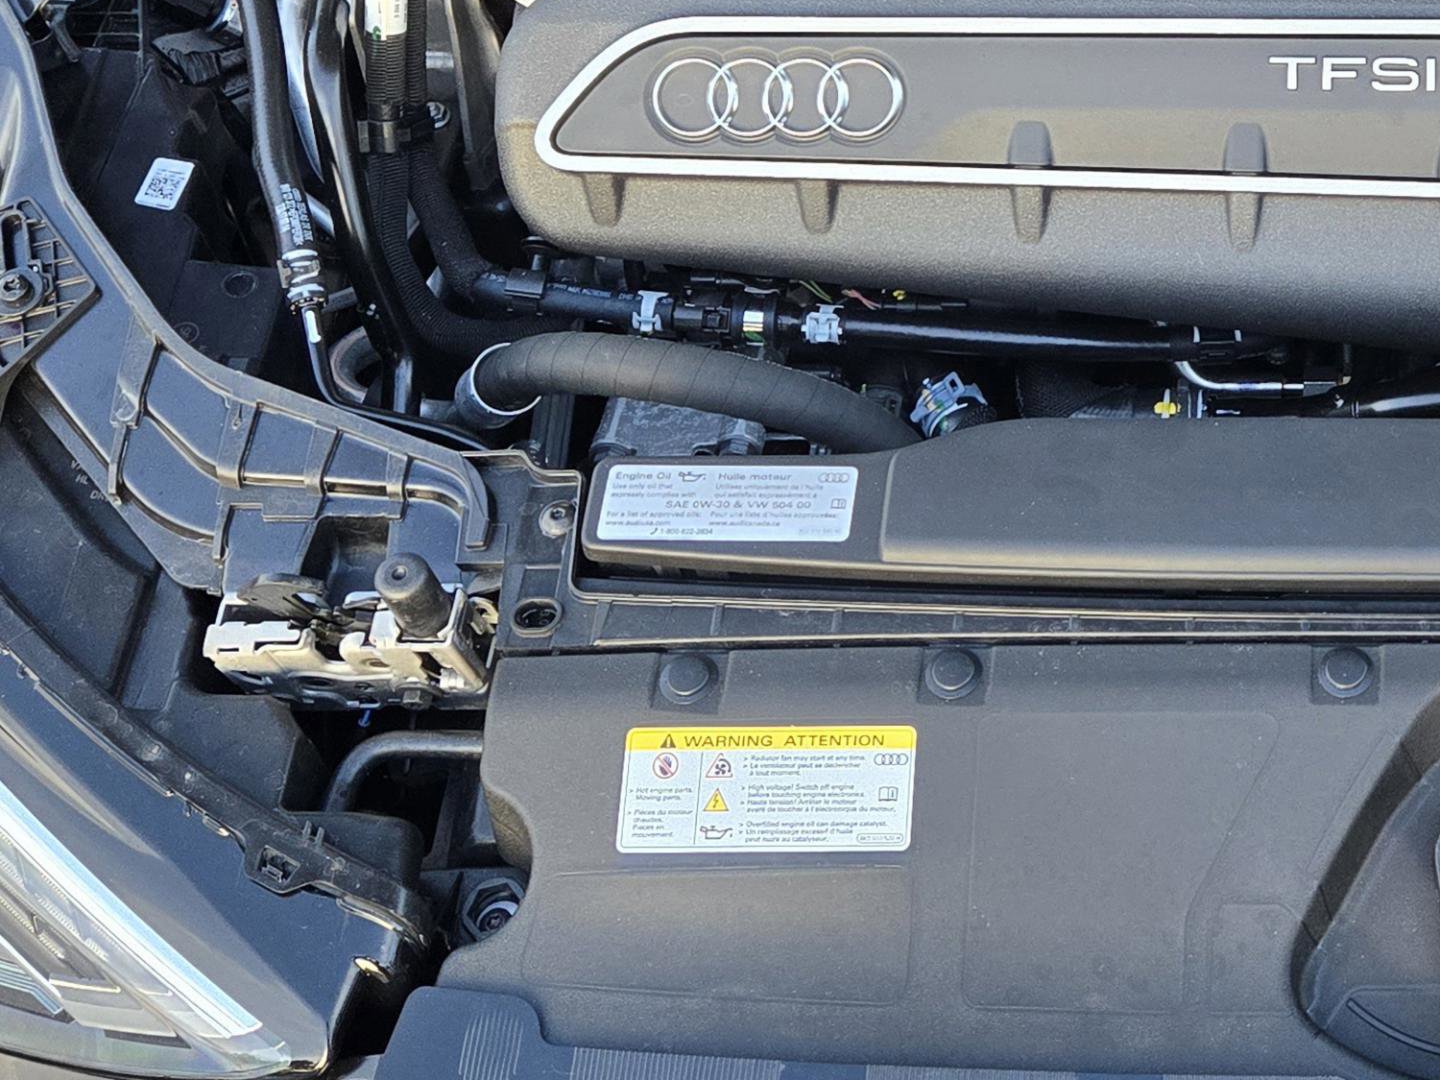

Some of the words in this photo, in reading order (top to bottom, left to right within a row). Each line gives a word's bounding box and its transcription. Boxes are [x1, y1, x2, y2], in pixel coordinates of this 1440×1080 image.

[1268, 56, 1436, 92] TFSI
[615, 472, 653, 481] Engine
[656, 472, 672, 480] Oil
[718, 473, 746, 481] Huile
[750, 473, 792, 481] moteur
[665, 500, 689, 509] SAE
[692, 501, 730, 509] 0W-30
[733, 501, 743, 509] &
[747, 501, 769, 509] VW
[772, 501, 793, 509] 504
[796, 501, 812, 509] 00
[649, 511, 685, 519] approved
[684, 735, 773, 748] WARNING
[784, 735, 885, 747] ATTENTION
[771, 791, 801, 799] touching
